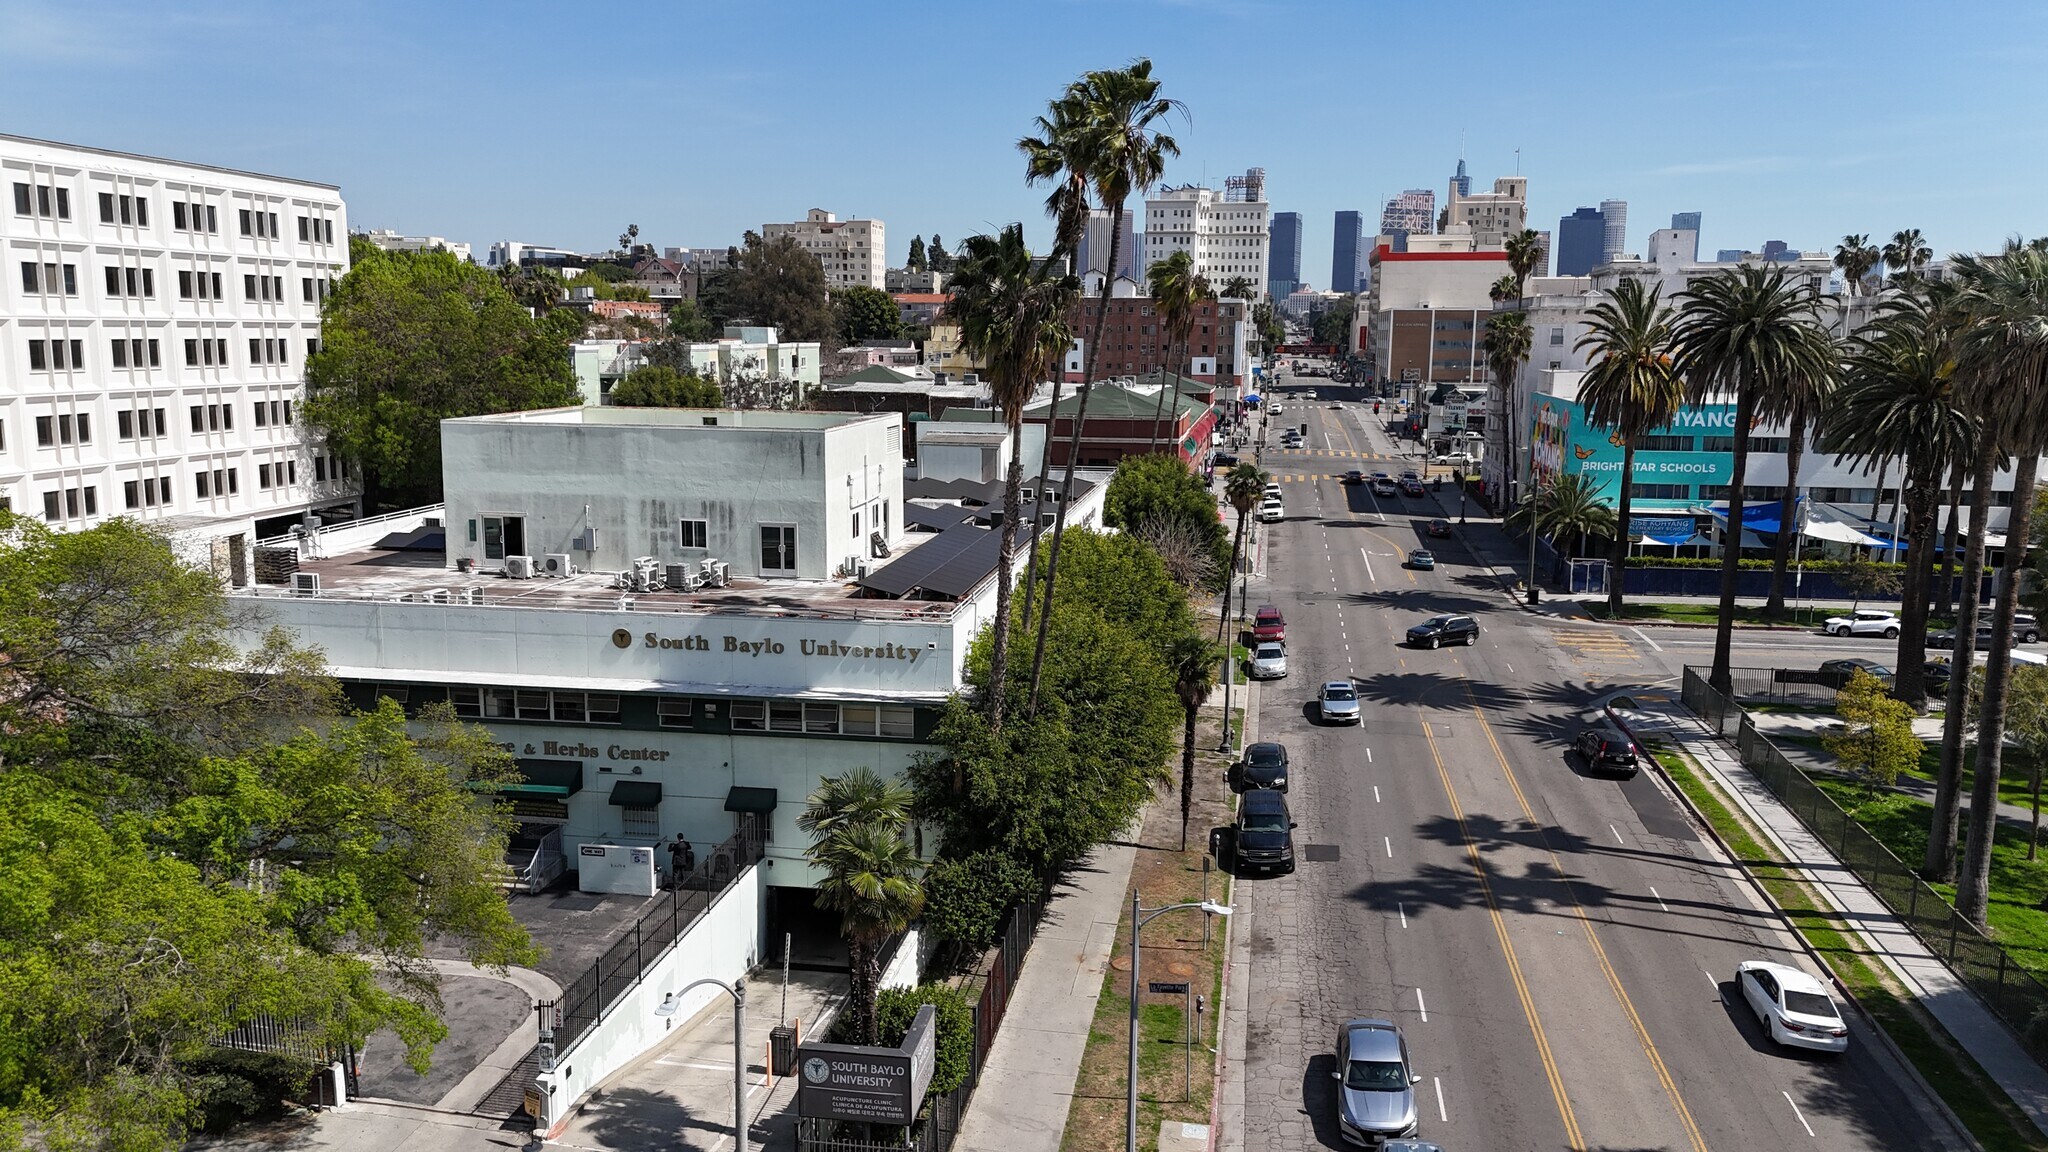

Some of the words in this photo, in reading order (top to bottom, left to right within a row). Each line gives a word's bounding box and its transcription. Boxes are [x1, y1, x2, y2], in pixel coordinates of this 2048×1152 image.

[1396, 194, 1434, 211] STORAGE
[1671, 411, 1737, 428] HYANG
[1582, 461, 1624, 471] BRIGHT
[1633, 463, 1656, 472] TAR
[1659, 463, 1717, 473] SCHOOLS
[645, 632, 710, 651] South
[723, 636, 785, 657] Baylo
[800, 639, 922, 664] University
[523, 743, 536, 755] &
[543, 741, 599, 758] Herbs
[607, 744, 670, 762] Center
[832, 1061, 868, 1073] SOUTH
[871, 1065, 905, 1076] BAYLO
[832, 1074, 893, 1087] UNIVERSITY
[832, 1096, 872, 1104] ACUPUNCTURE
[864, 1104, 902, 1112] ACUPUNTURA
